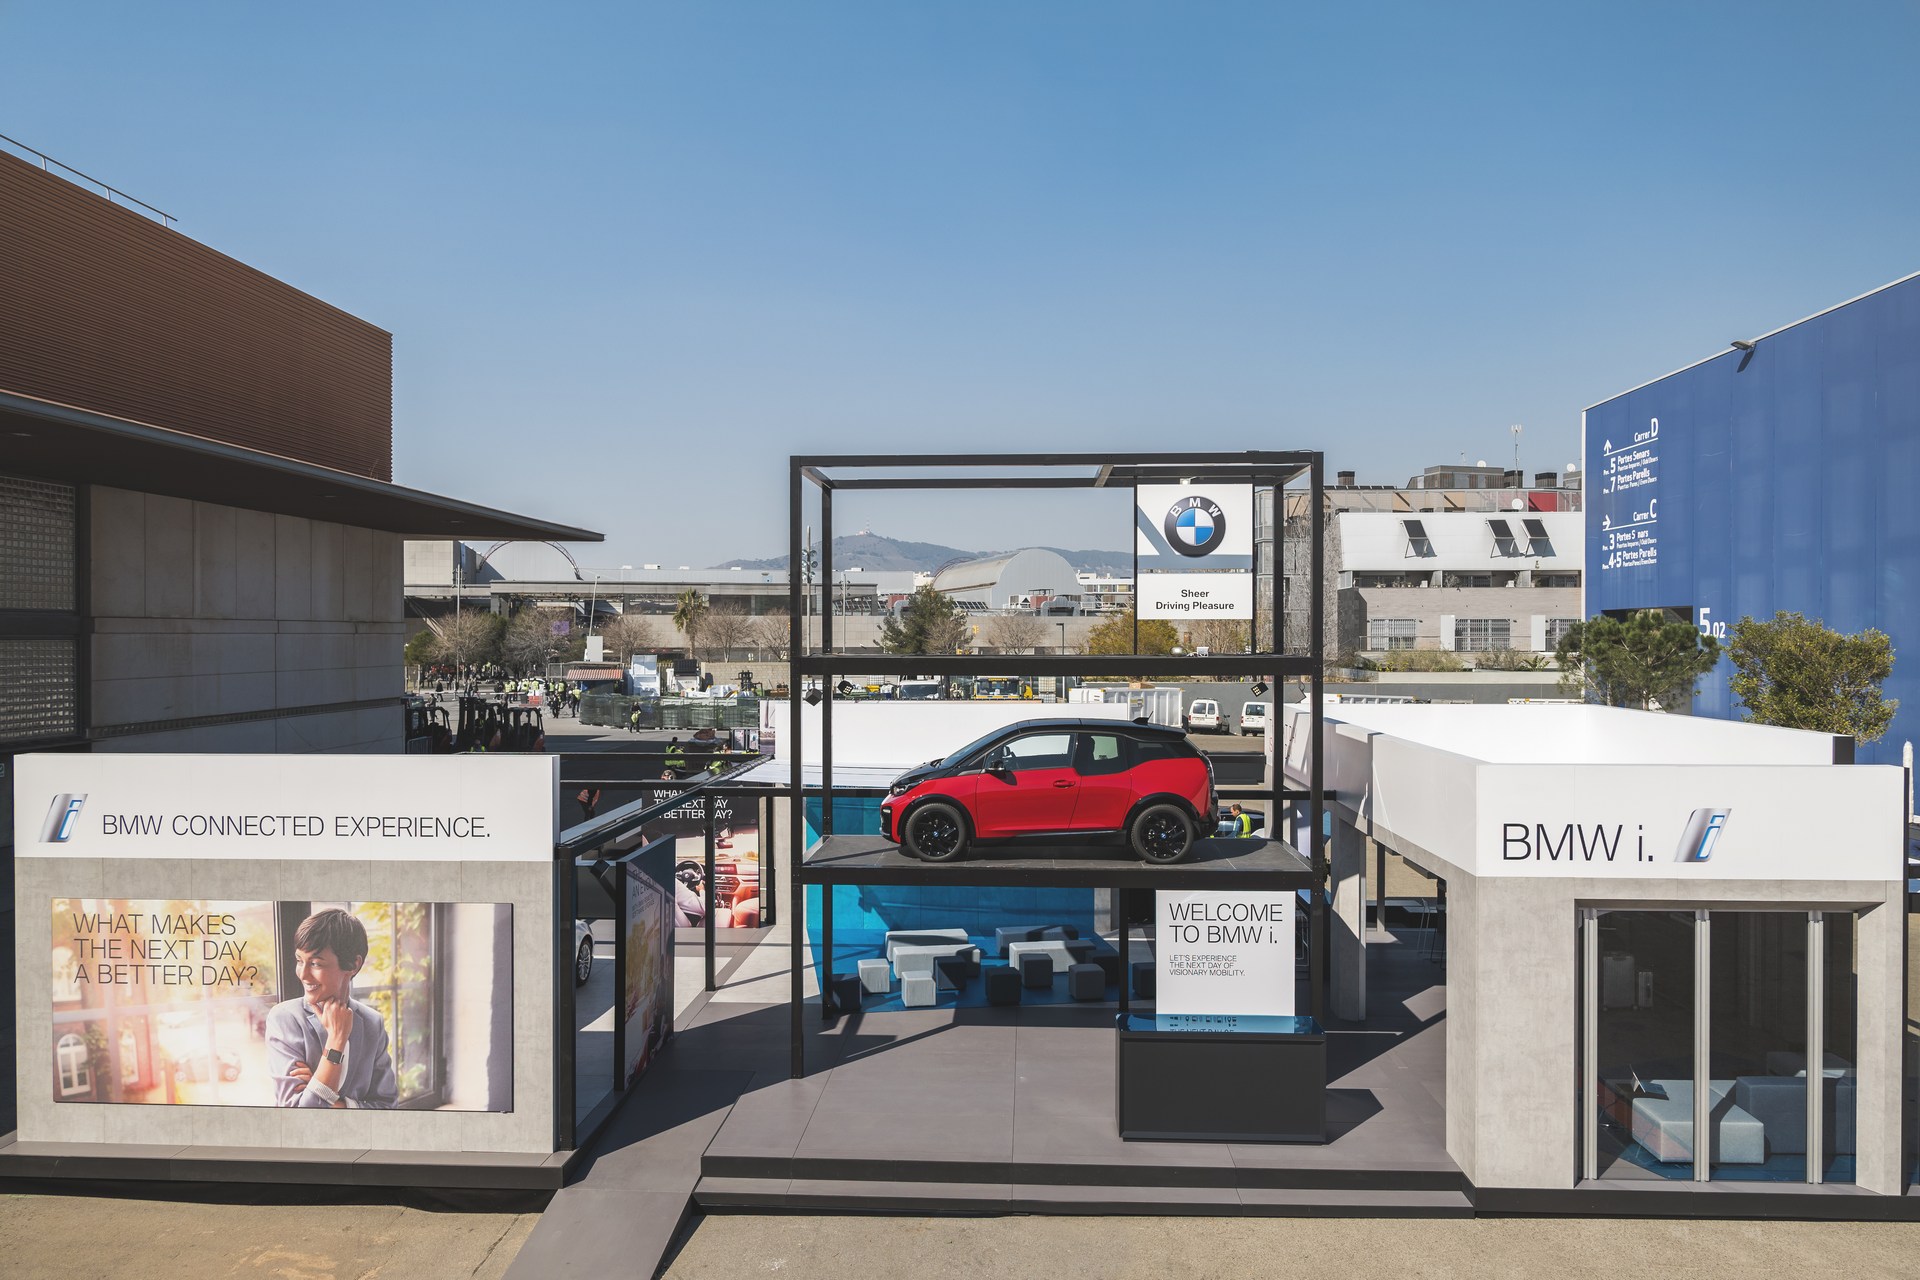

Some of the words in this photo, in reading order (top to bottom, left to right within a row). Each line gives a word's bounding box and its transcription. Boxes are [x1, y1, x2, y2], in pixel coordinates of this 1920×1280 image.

[1634, 431, 1650, 442] Carrer
[1651, 417, 1659, 438] D
[1610, 457, 1616, 474] 5
[1618, 454, 1632, 465] Portes
[1633, 450, 1650, 460] Senars
[1610, 476, 1616, 492] 7
[1618, 474, 1632, 484] Portes
[1633, 468, 1650, 480] Parells
[1170, 498, 1222, 518] BMW
[1633, 512, 1649, 521] Carrer
[1650, 498, 1657, 518] C
[1610, 534, 1614, 550] 3
[1616, 532, 1631, 542] Portes
[1623, 550, 1638, 560] Portes
[1639, 547, 1657, 558] Parells
[1181, 589, 1210, 598] Sheer
[1156, 601, 1190, 611] Driving
[1192, 601, 1234, 610] Pleasure
[654, 790, 684, 798] WHA
[664, 810, 706, 819] BETTER
[714, 809, 733, 819] AY?
[103, 814, 163, 835] BMW
[172, 815, 324, 836] CONNECTED
[335, 816, 491, 838] EXPERIENCE.
[1502, 823, 1623, 862] BMW
[1638, 824, 1654, 862] i.
[1169, 903, 1283, 922] WELCOME
[73, 913, 144, 934] WHAT
[152, 914, 236, 936] MAKES
[1169, 925, 1200, 943] TO
[1208, 926, 1262, 944] BMW
[1269, 926, 1278, 944] i.
[74, 938, 122, 959] THE
[131, 939, 194, 960] NEXT
[203, 940, 247, 961] DAY
[74, 964, 90, 984] A
[98, 964, 193, 985] BETTER
[202, 965, 258, 986] DAY?
